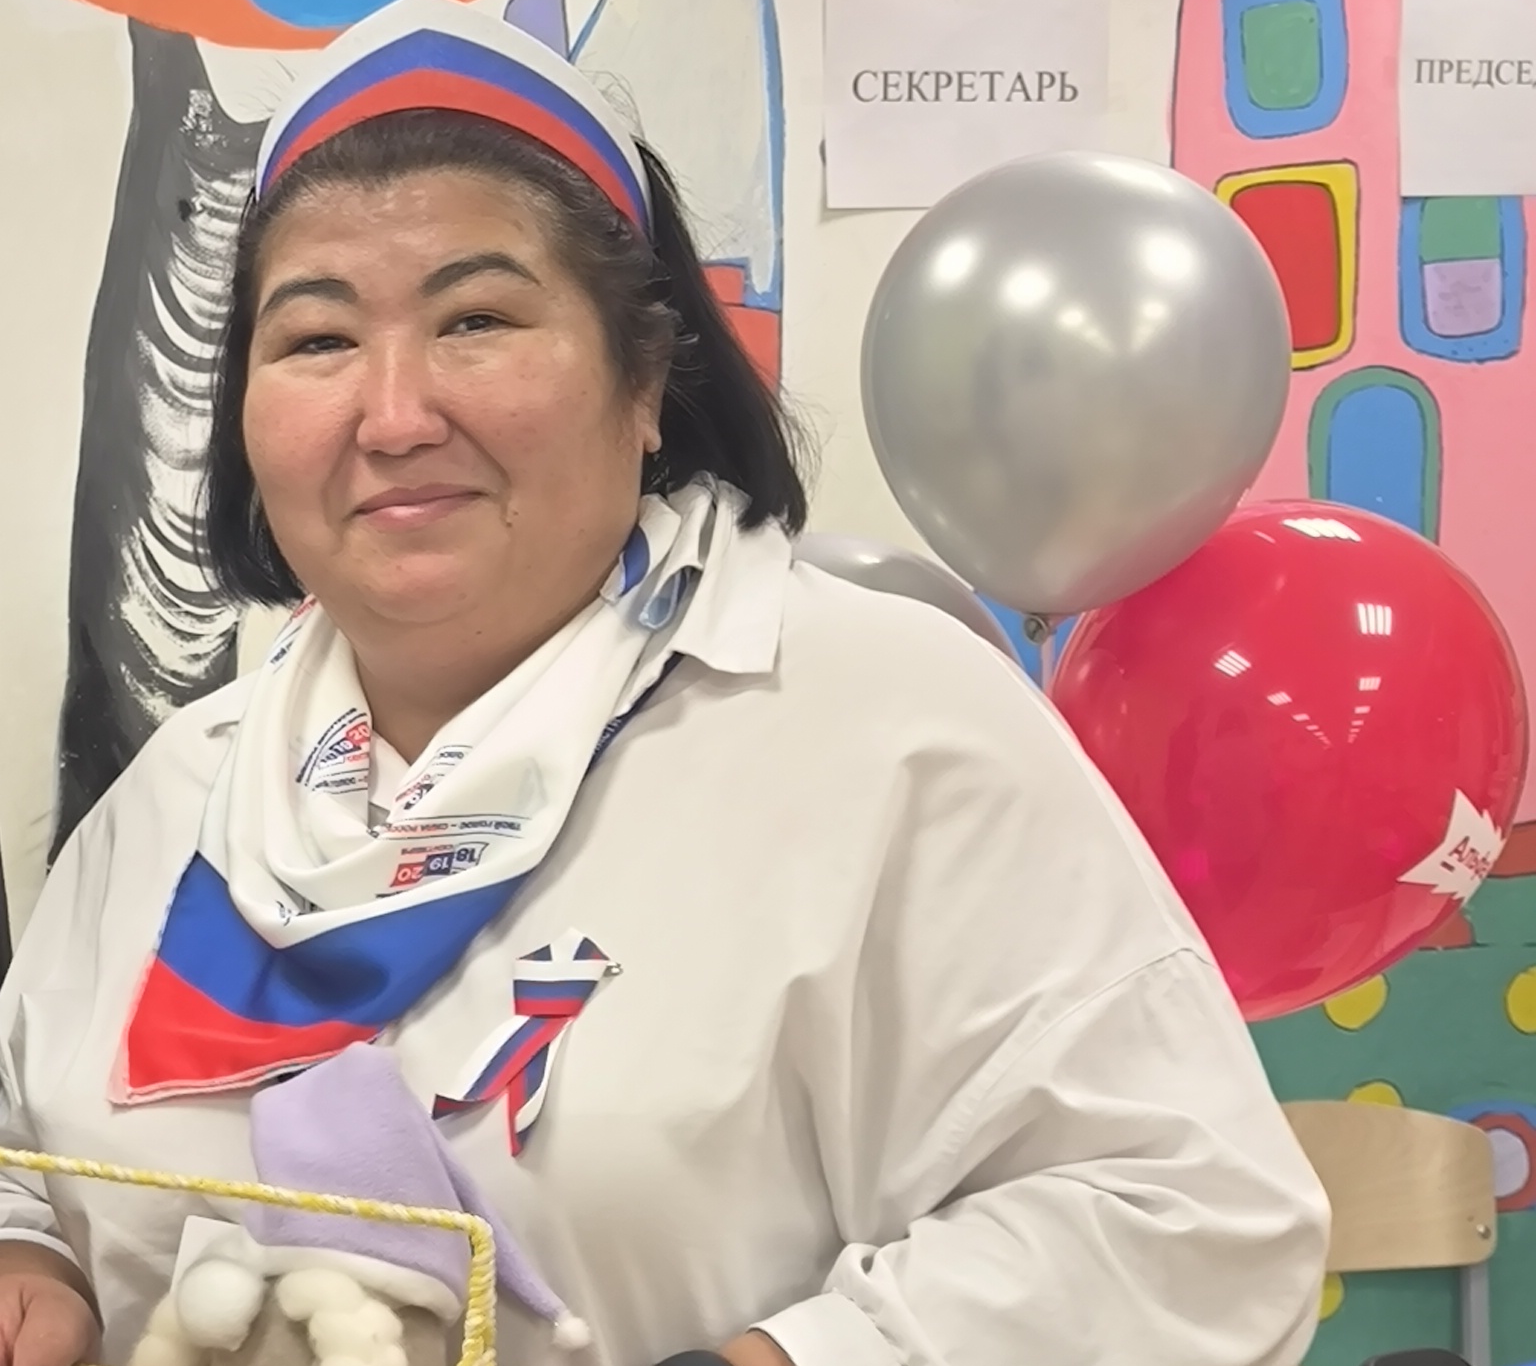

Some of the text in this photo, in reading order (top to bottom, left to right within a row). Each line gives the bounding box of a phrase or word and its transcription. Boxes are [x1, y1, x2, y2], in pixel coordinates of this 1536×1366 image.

[852, 69, 1079, 103] СЕКРЕТАРЬ
[1414, 58, 1536, 90] ПРЕДСЕ
[397, 847, 476, 882] 18 19 20
